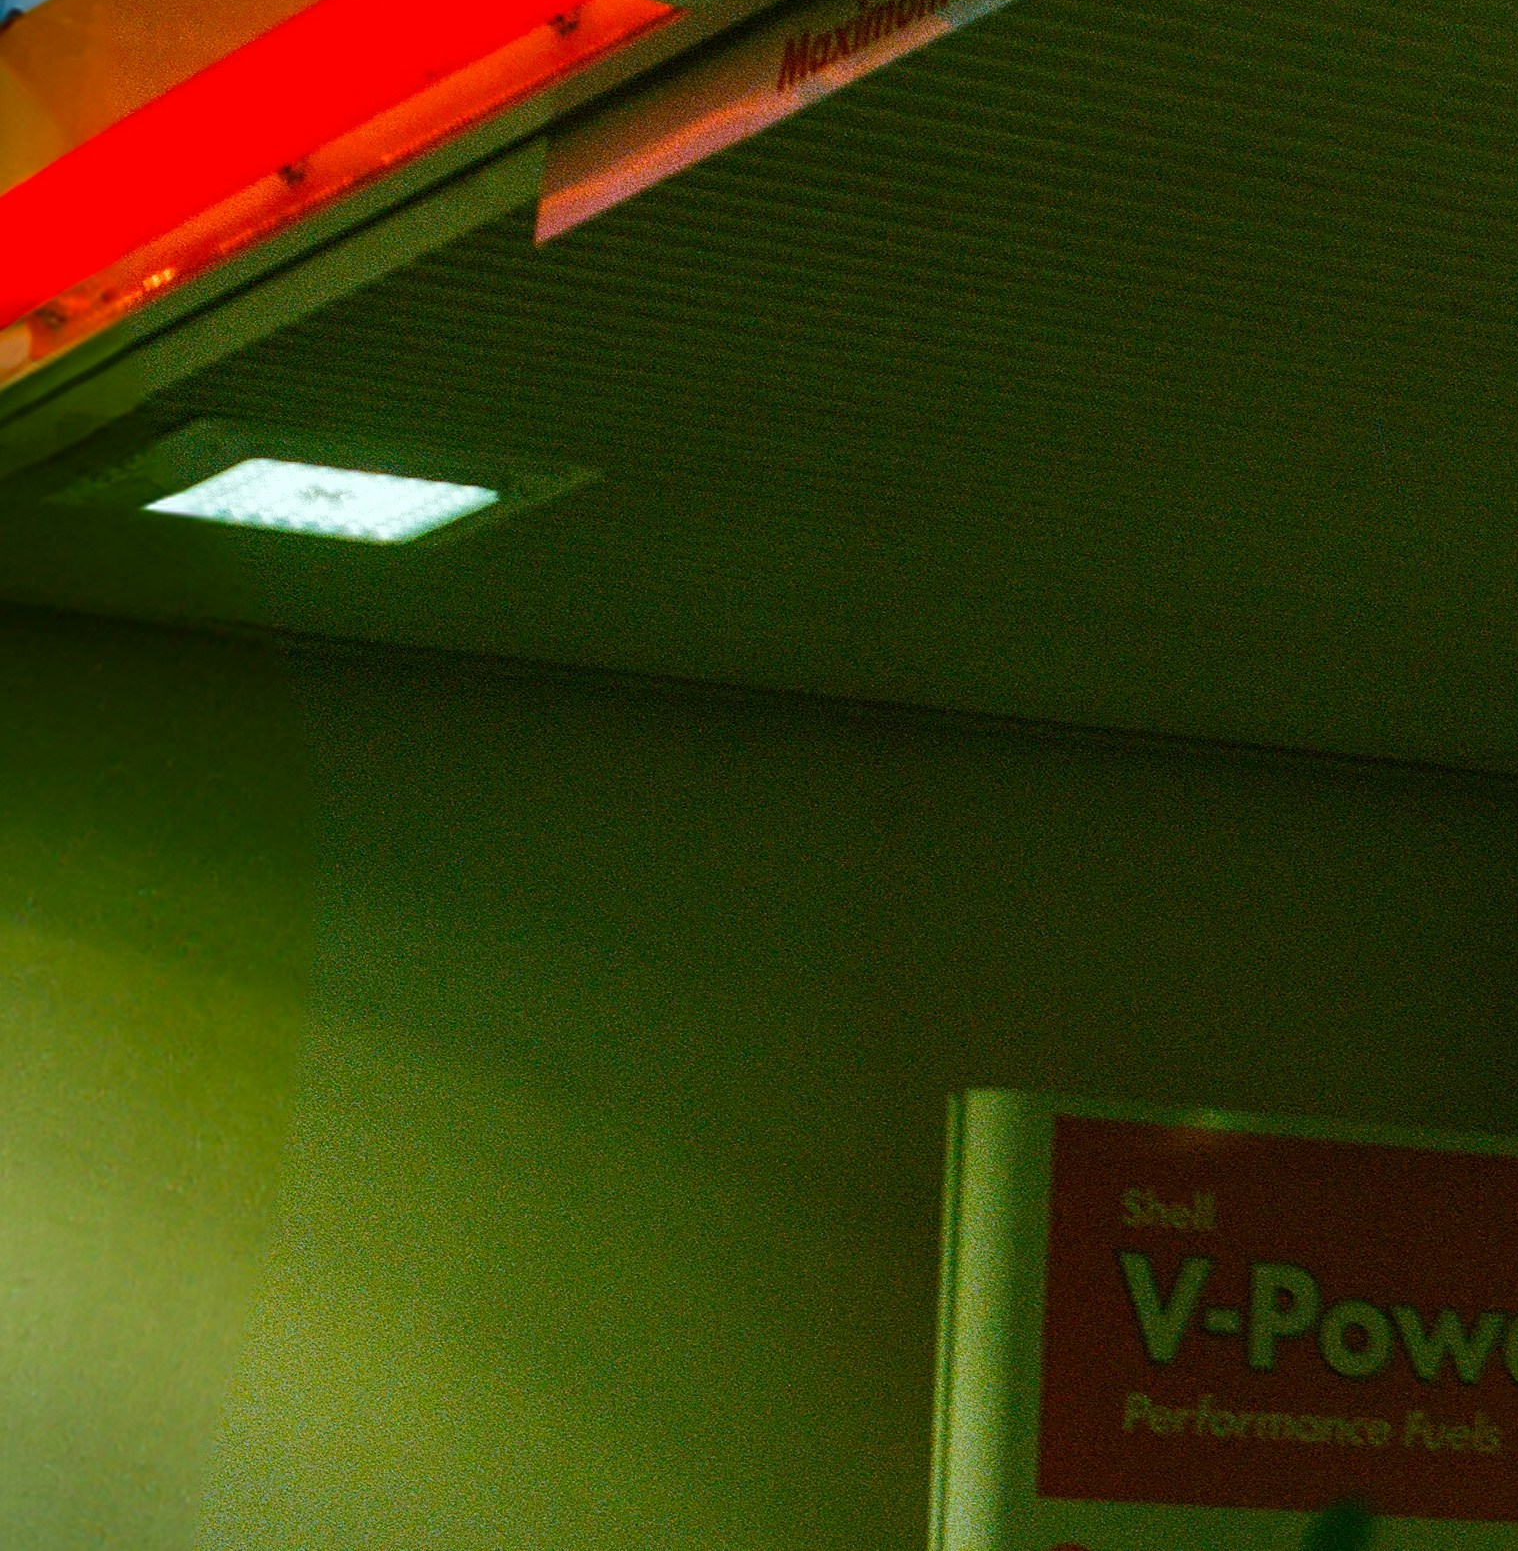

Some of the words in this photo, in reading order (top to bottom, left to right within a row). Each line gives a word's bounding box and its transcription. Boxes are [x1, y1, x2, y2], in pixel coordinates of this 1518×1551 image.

[1119, 1186, 1217, 1233] Shell
[1122, 1390, 1392, 1450] Performance
[1401, 1411, 1505, 1457] Fuels
